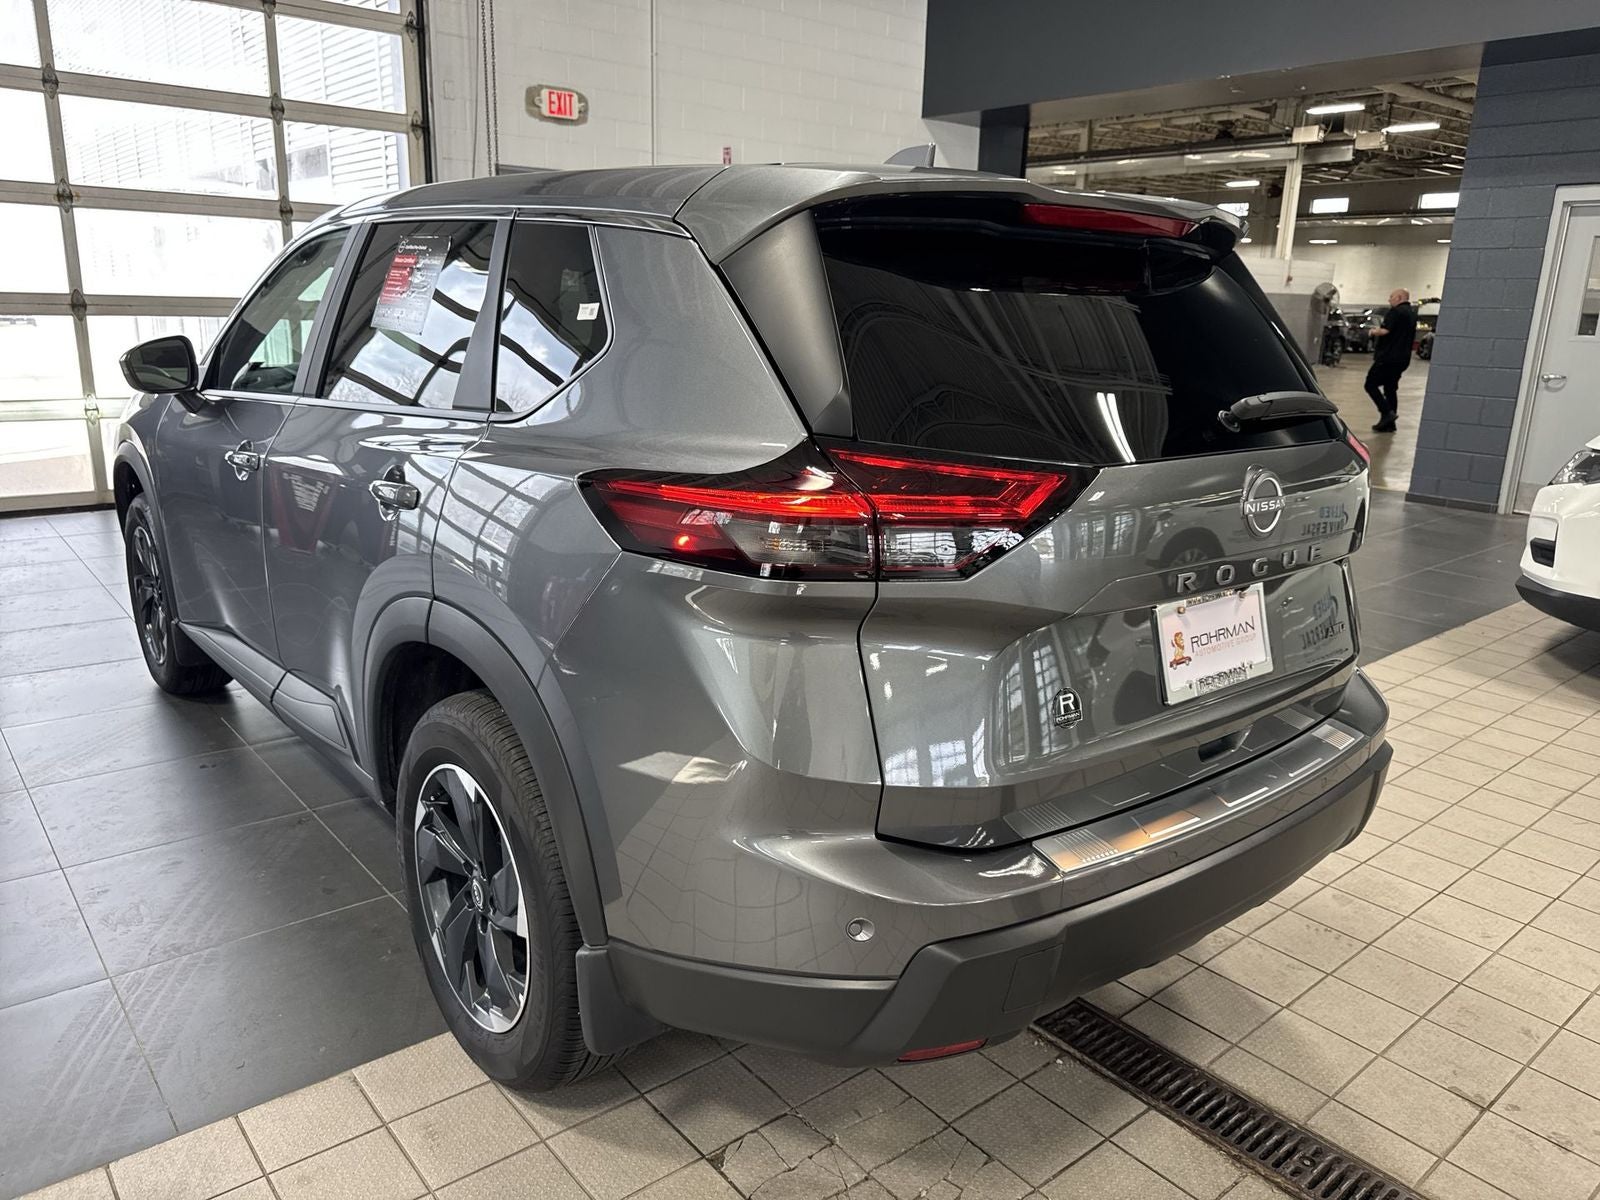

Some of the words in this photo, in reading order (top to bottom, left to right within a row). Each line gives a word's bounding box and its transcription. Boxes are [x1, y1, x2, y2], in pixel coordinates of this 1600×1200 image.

[548, 91, 574, 117] EXIT
[1246, 499, 1286, 513] NISSAN
[1176, 545, 1321, 593] ROGUE
[1190, 616, 1255, 653] ROHRMAN
[1060, 693, 1075, 715] R
